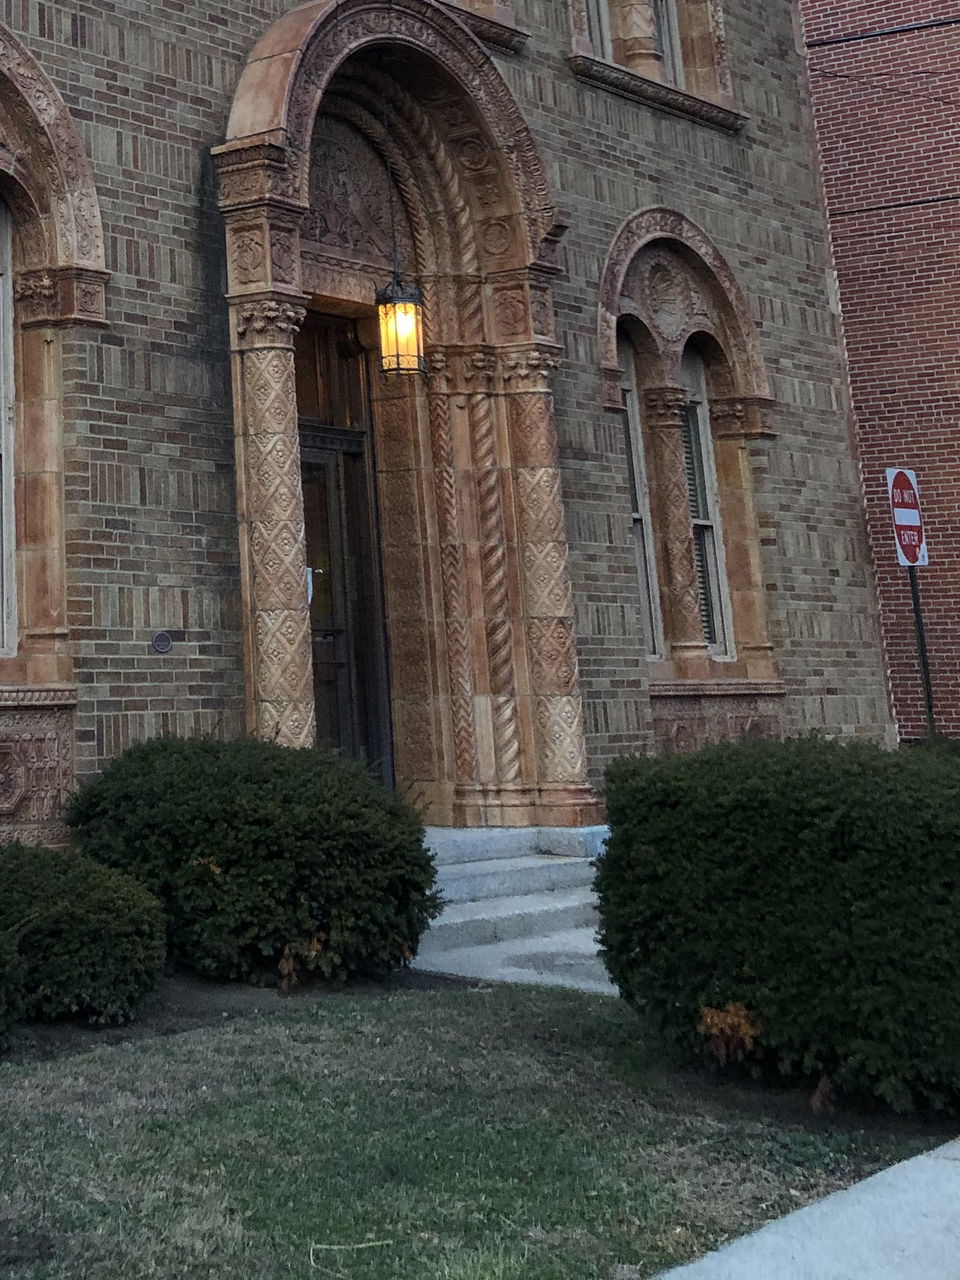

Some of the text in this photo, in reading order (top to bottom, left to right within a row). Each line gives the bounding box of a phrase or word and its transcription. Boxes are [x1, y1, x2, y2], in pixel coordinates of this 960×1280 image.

[893, 488, 915, 504] DO NOT
[900, 530, 919, 545] ENTER
